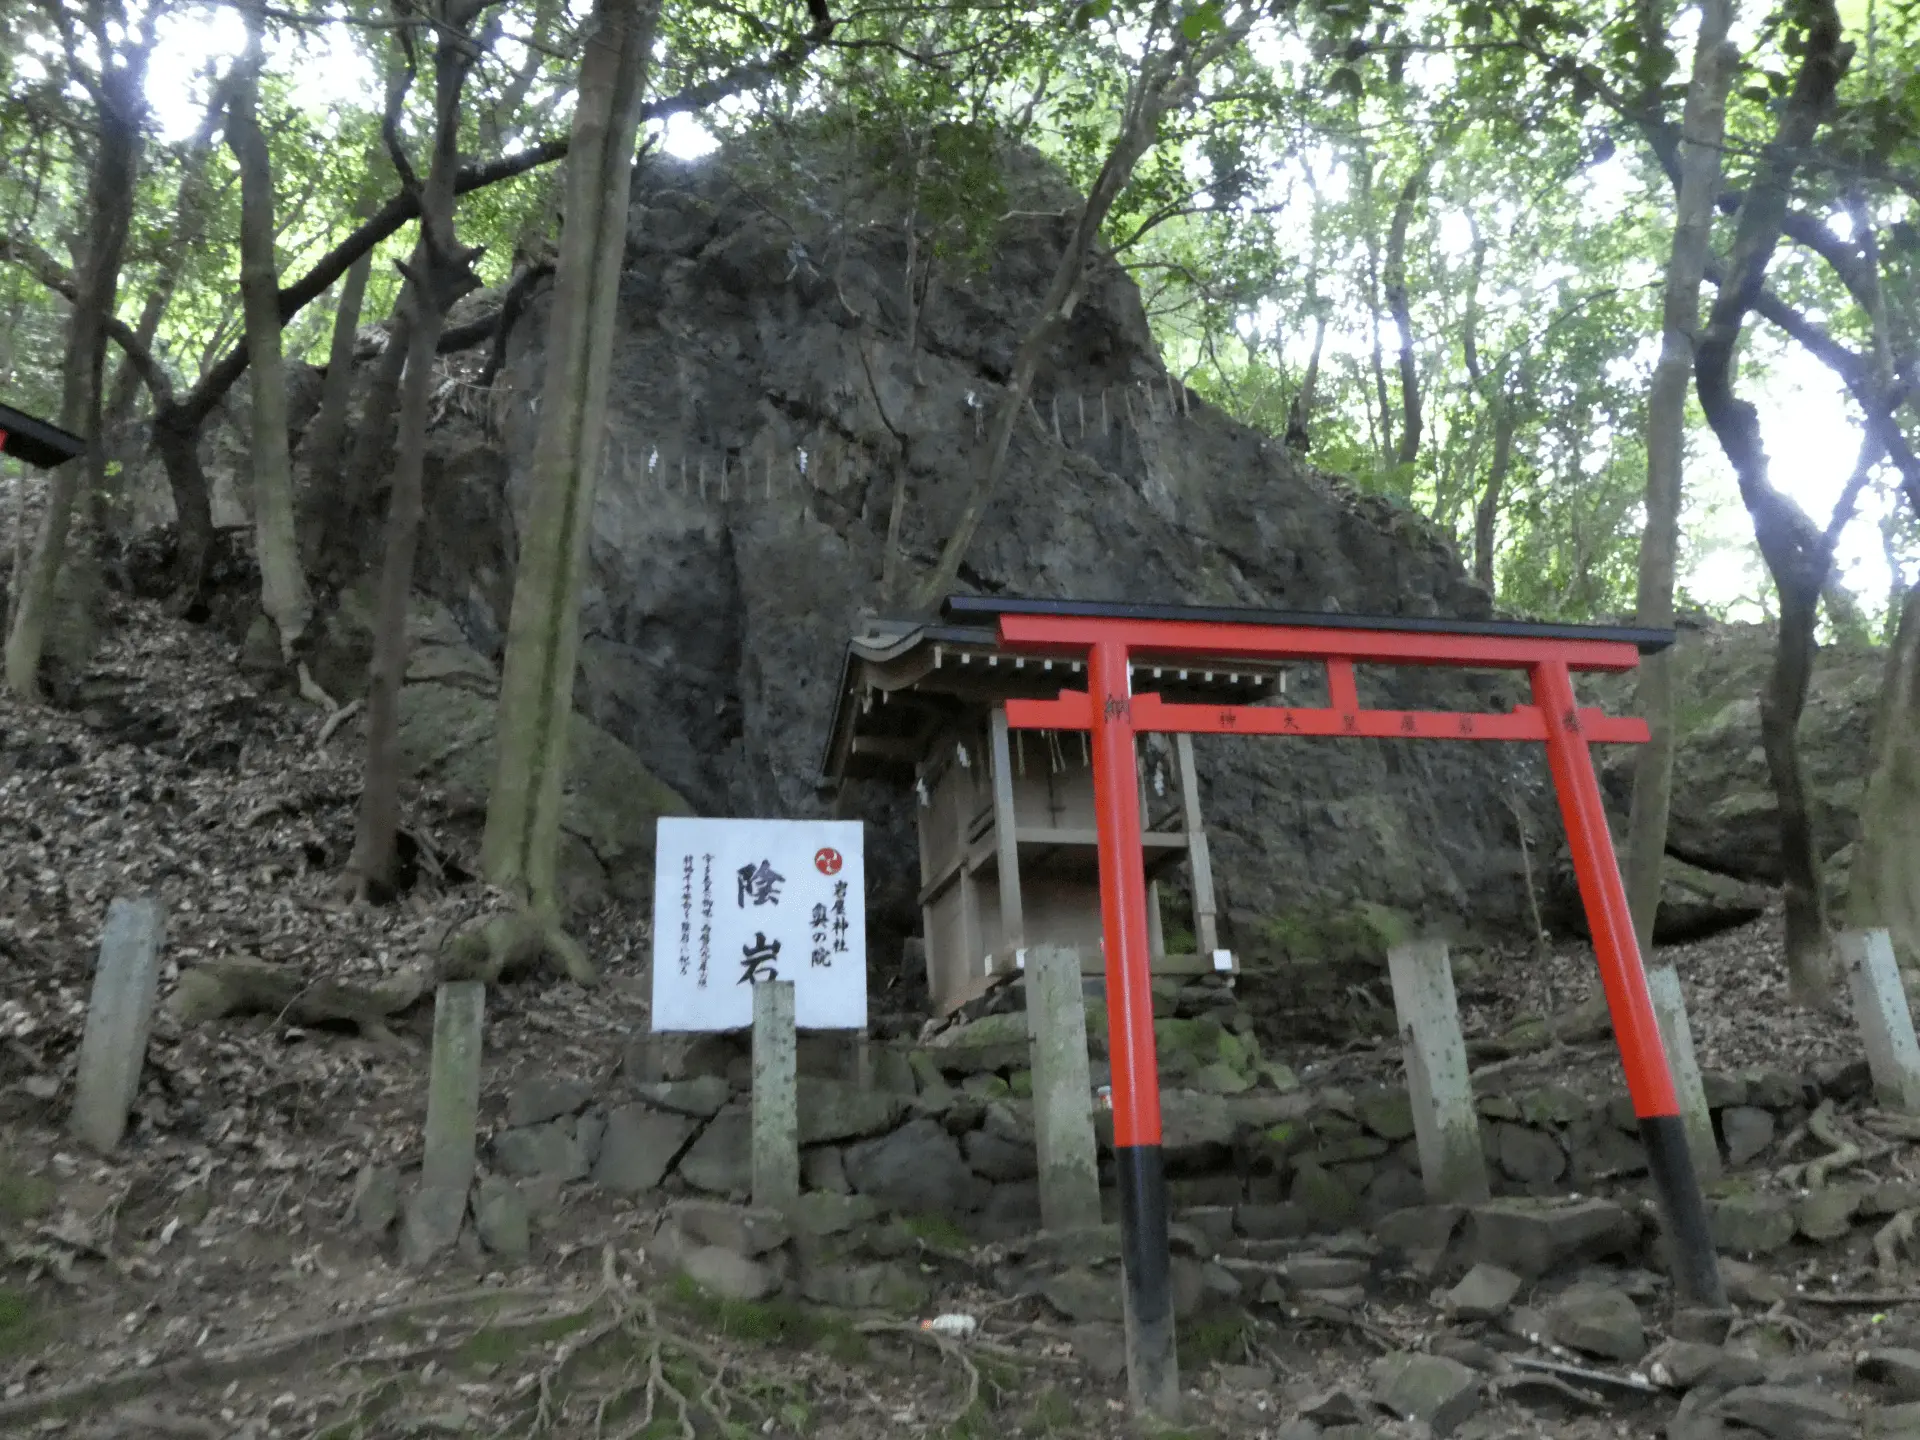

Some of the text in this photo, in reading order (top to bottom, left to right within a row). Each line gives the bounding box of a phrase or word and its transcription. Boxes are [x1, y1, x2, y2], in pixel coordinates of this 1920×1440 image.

[736, 859, 786, 986] 陰岩
[809, 902, 832, 968] 奥の院
[830, 879, 849, 954] 岩屋神社
